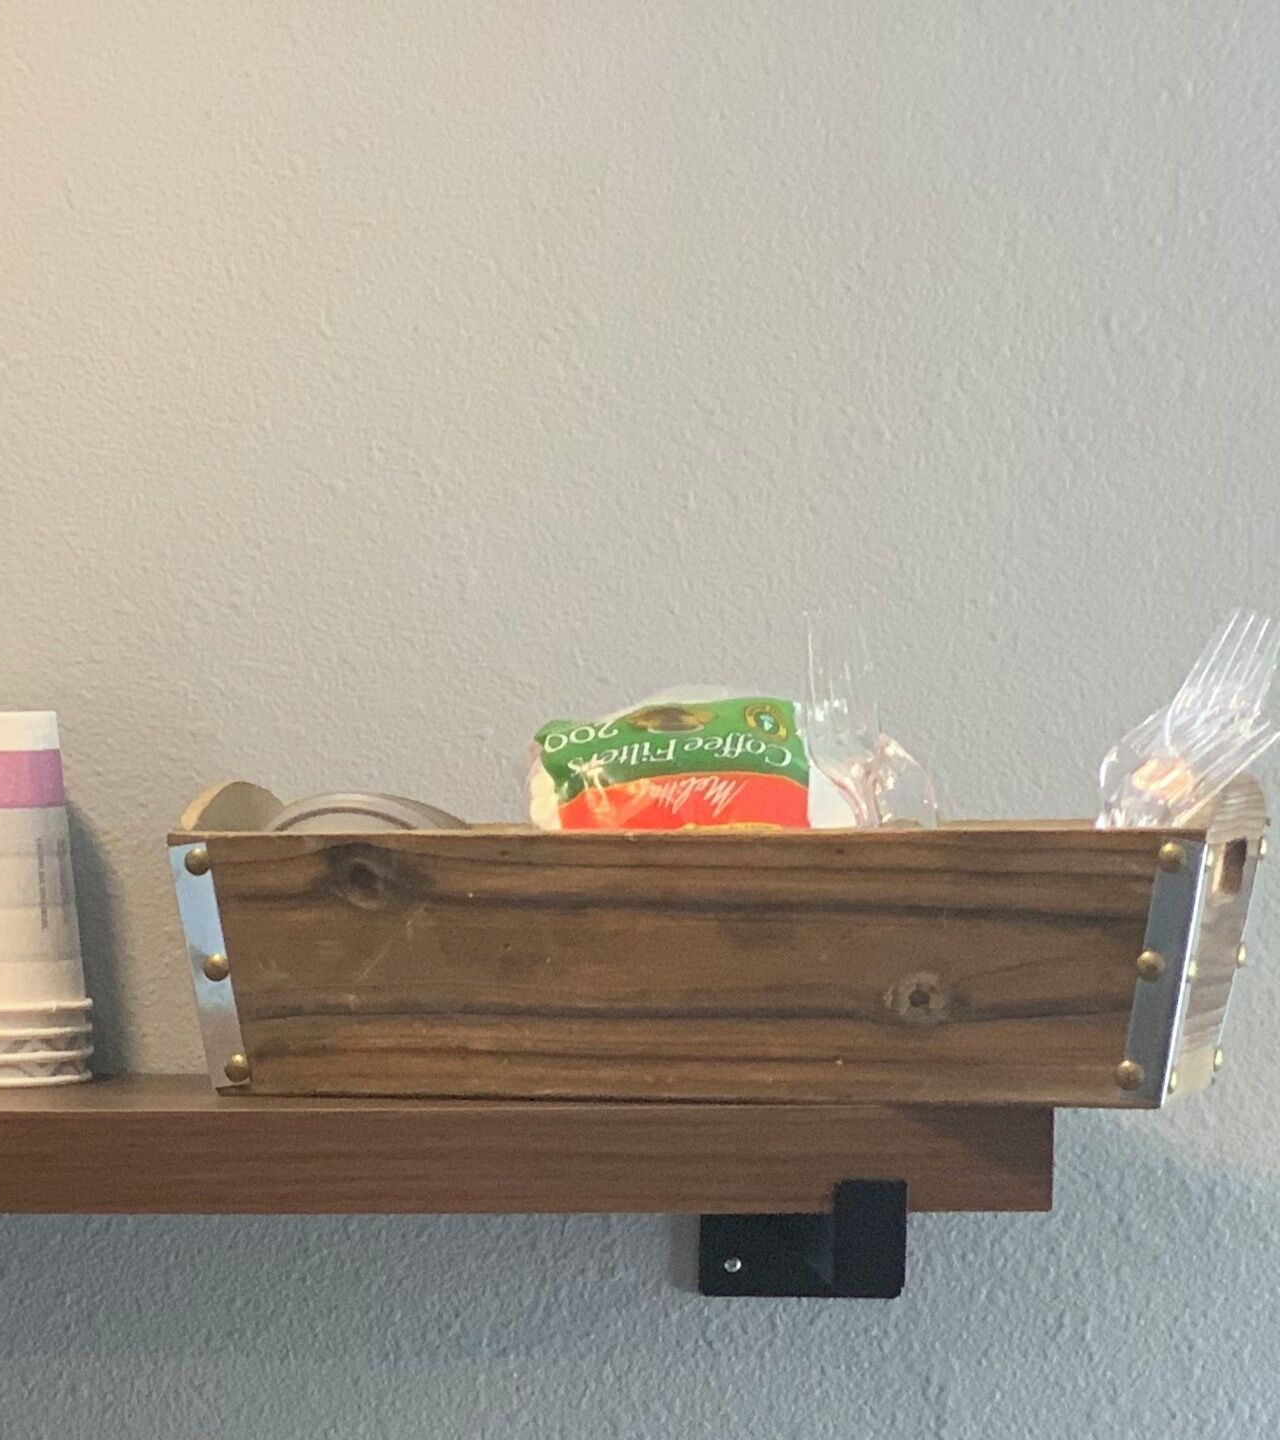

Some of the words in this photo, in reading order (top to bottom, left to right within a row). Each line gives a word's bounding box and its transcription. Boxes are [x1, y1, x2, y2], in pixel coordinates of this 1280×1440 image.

[543, 720, 619, 753] 200
[683, 732, 793, 768] Coffee
[567, 739, 676, 778] Filters
